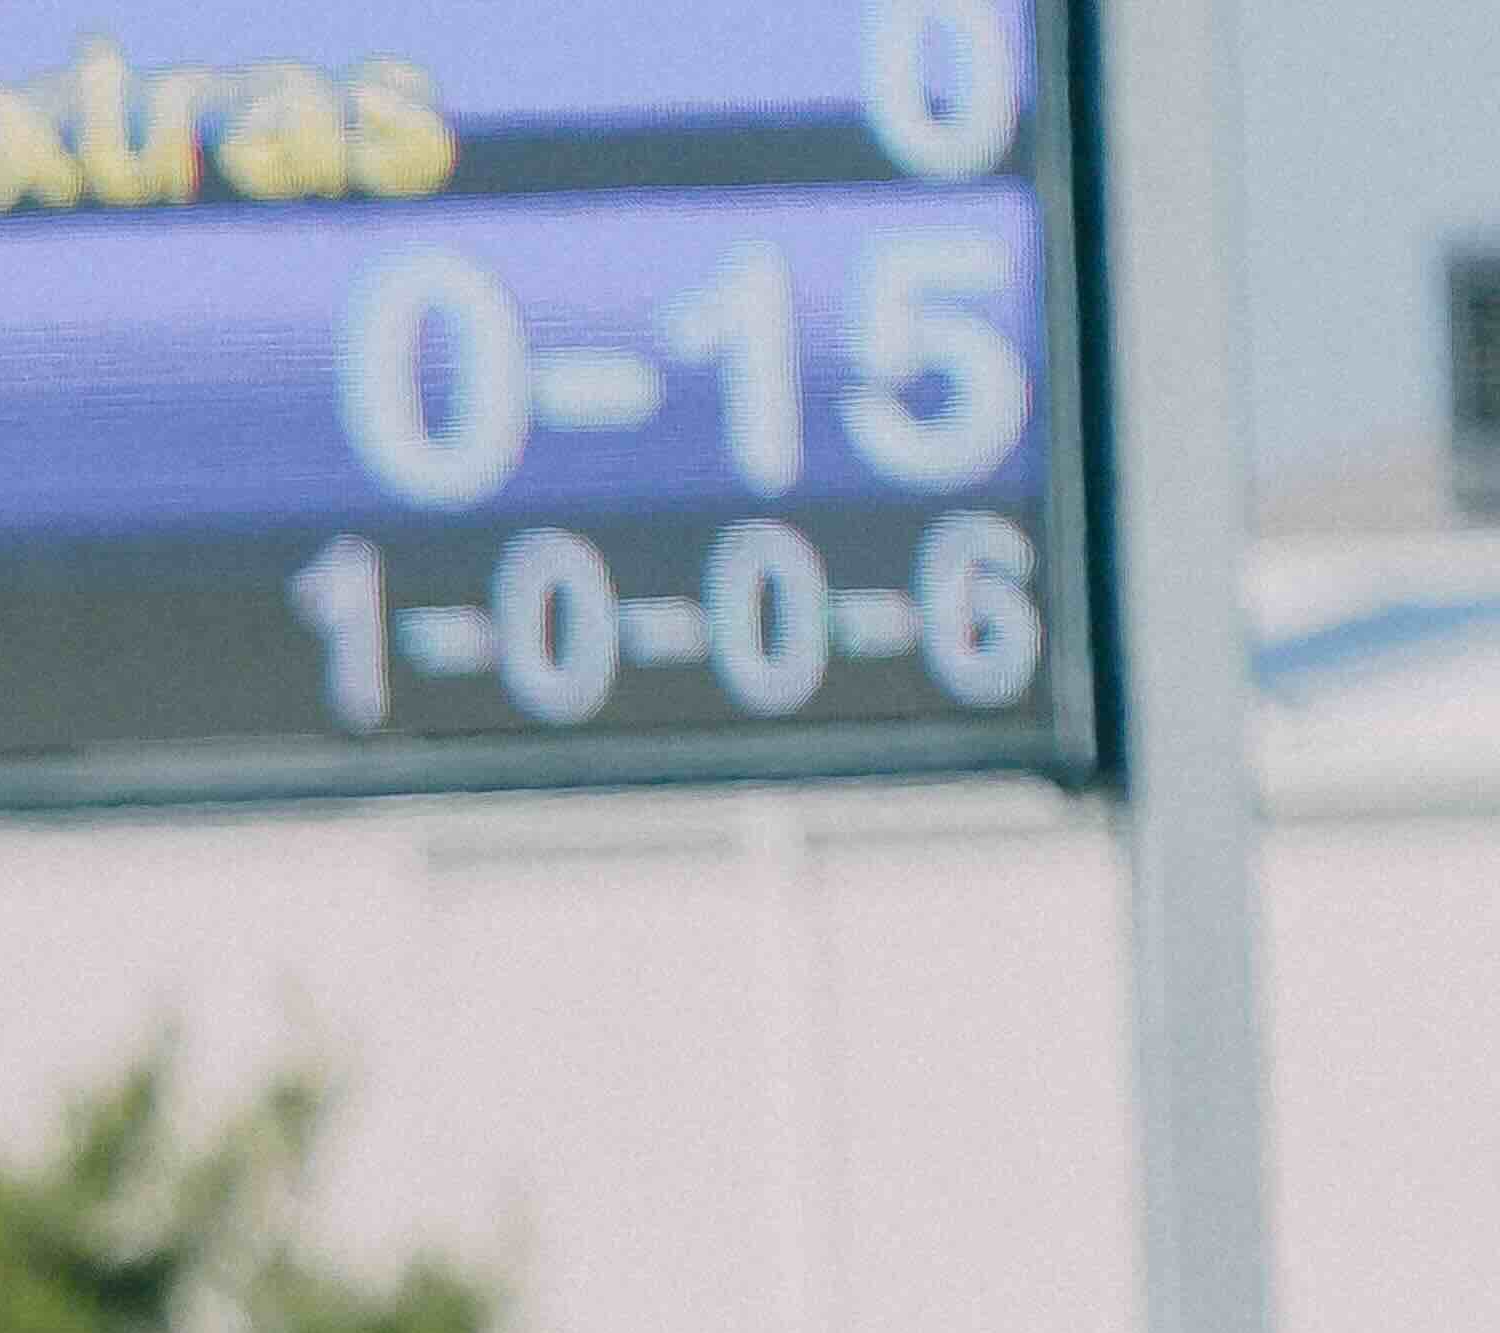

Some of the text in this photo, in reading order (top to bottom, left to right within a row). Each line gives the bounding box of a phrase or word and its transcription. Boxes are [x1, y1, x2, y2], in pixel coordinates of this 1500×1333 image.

[860, 0, 1021, 181] 0
[336, 226, 1033, 510] 0-15
[286, 509, 1044, 734] 1-0-0-6
